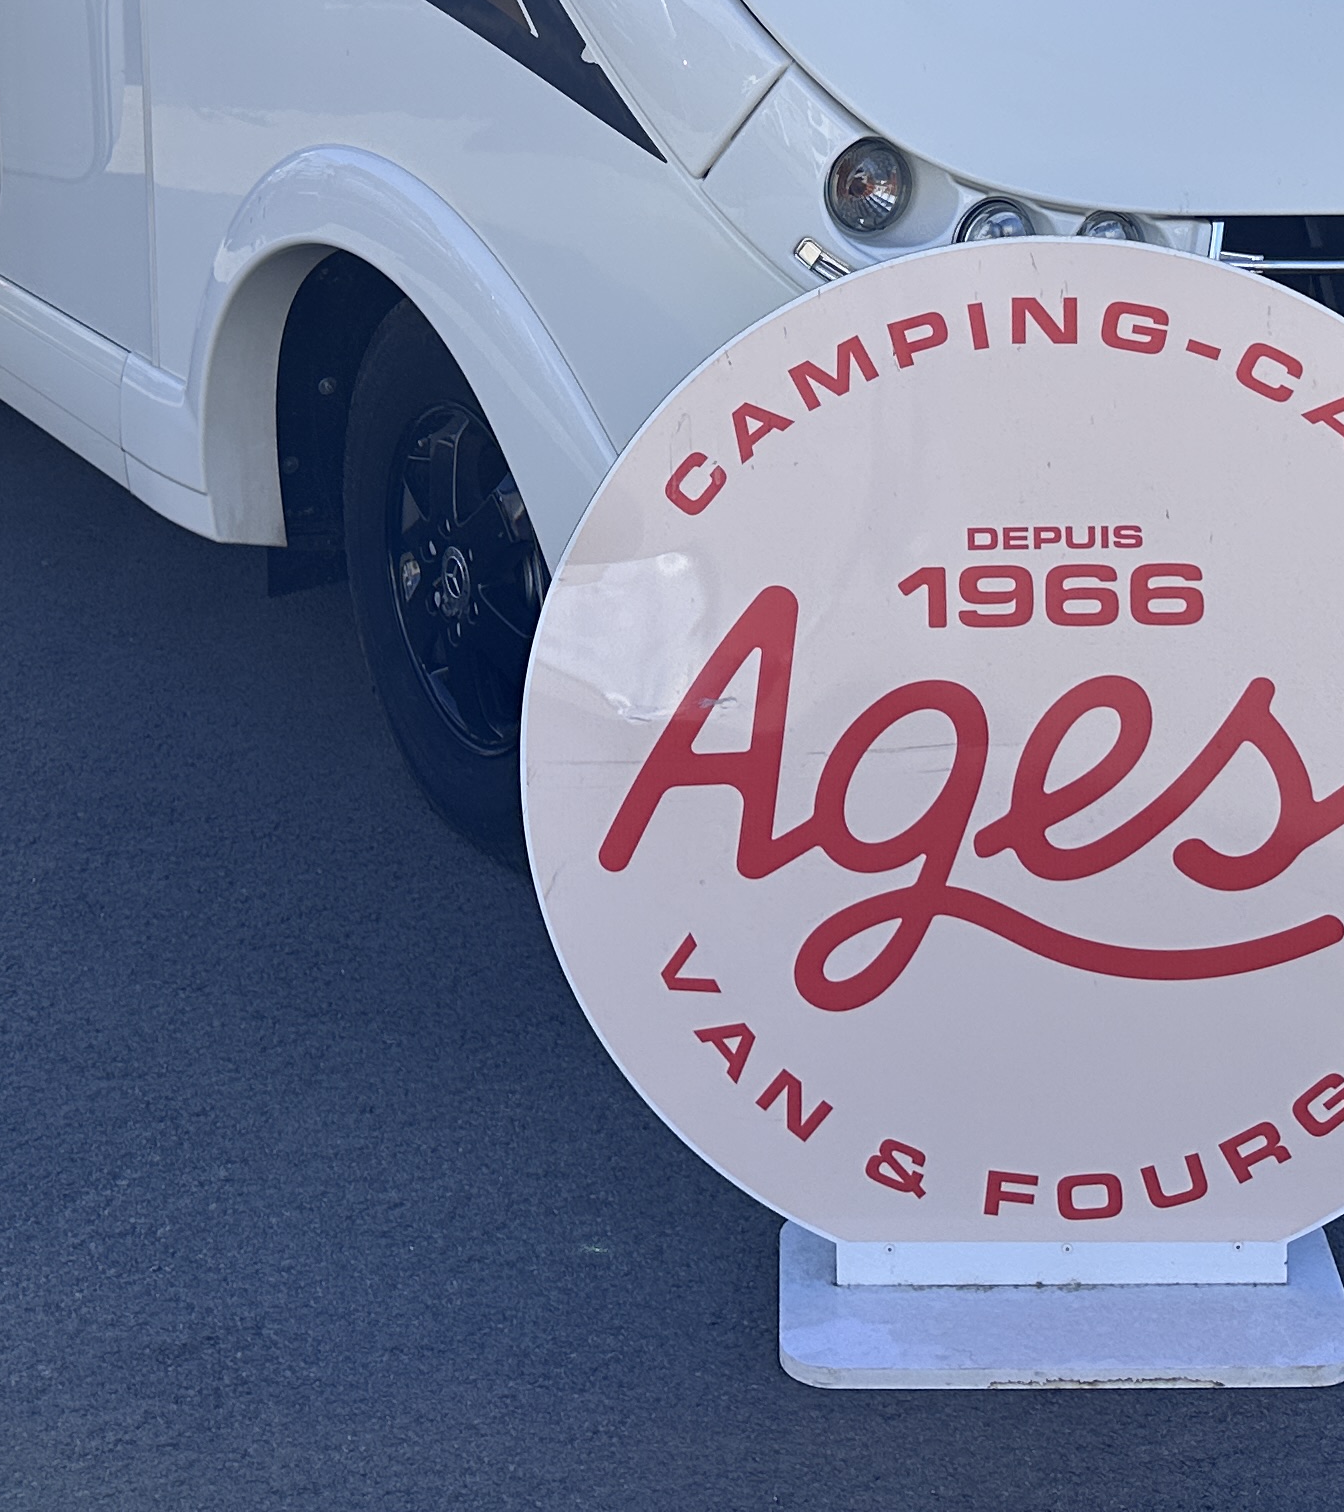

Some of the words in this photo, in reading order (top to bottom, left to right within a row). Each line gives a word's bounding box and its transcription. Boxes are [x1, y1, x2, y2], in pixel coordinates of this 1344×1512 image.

[966, 525, 1143, 550] DEPUIS
[898, 564, 1204, 628] 1966
[660, 934, 833, 1141] VAN
[866, 1139, 926, 1199] &
